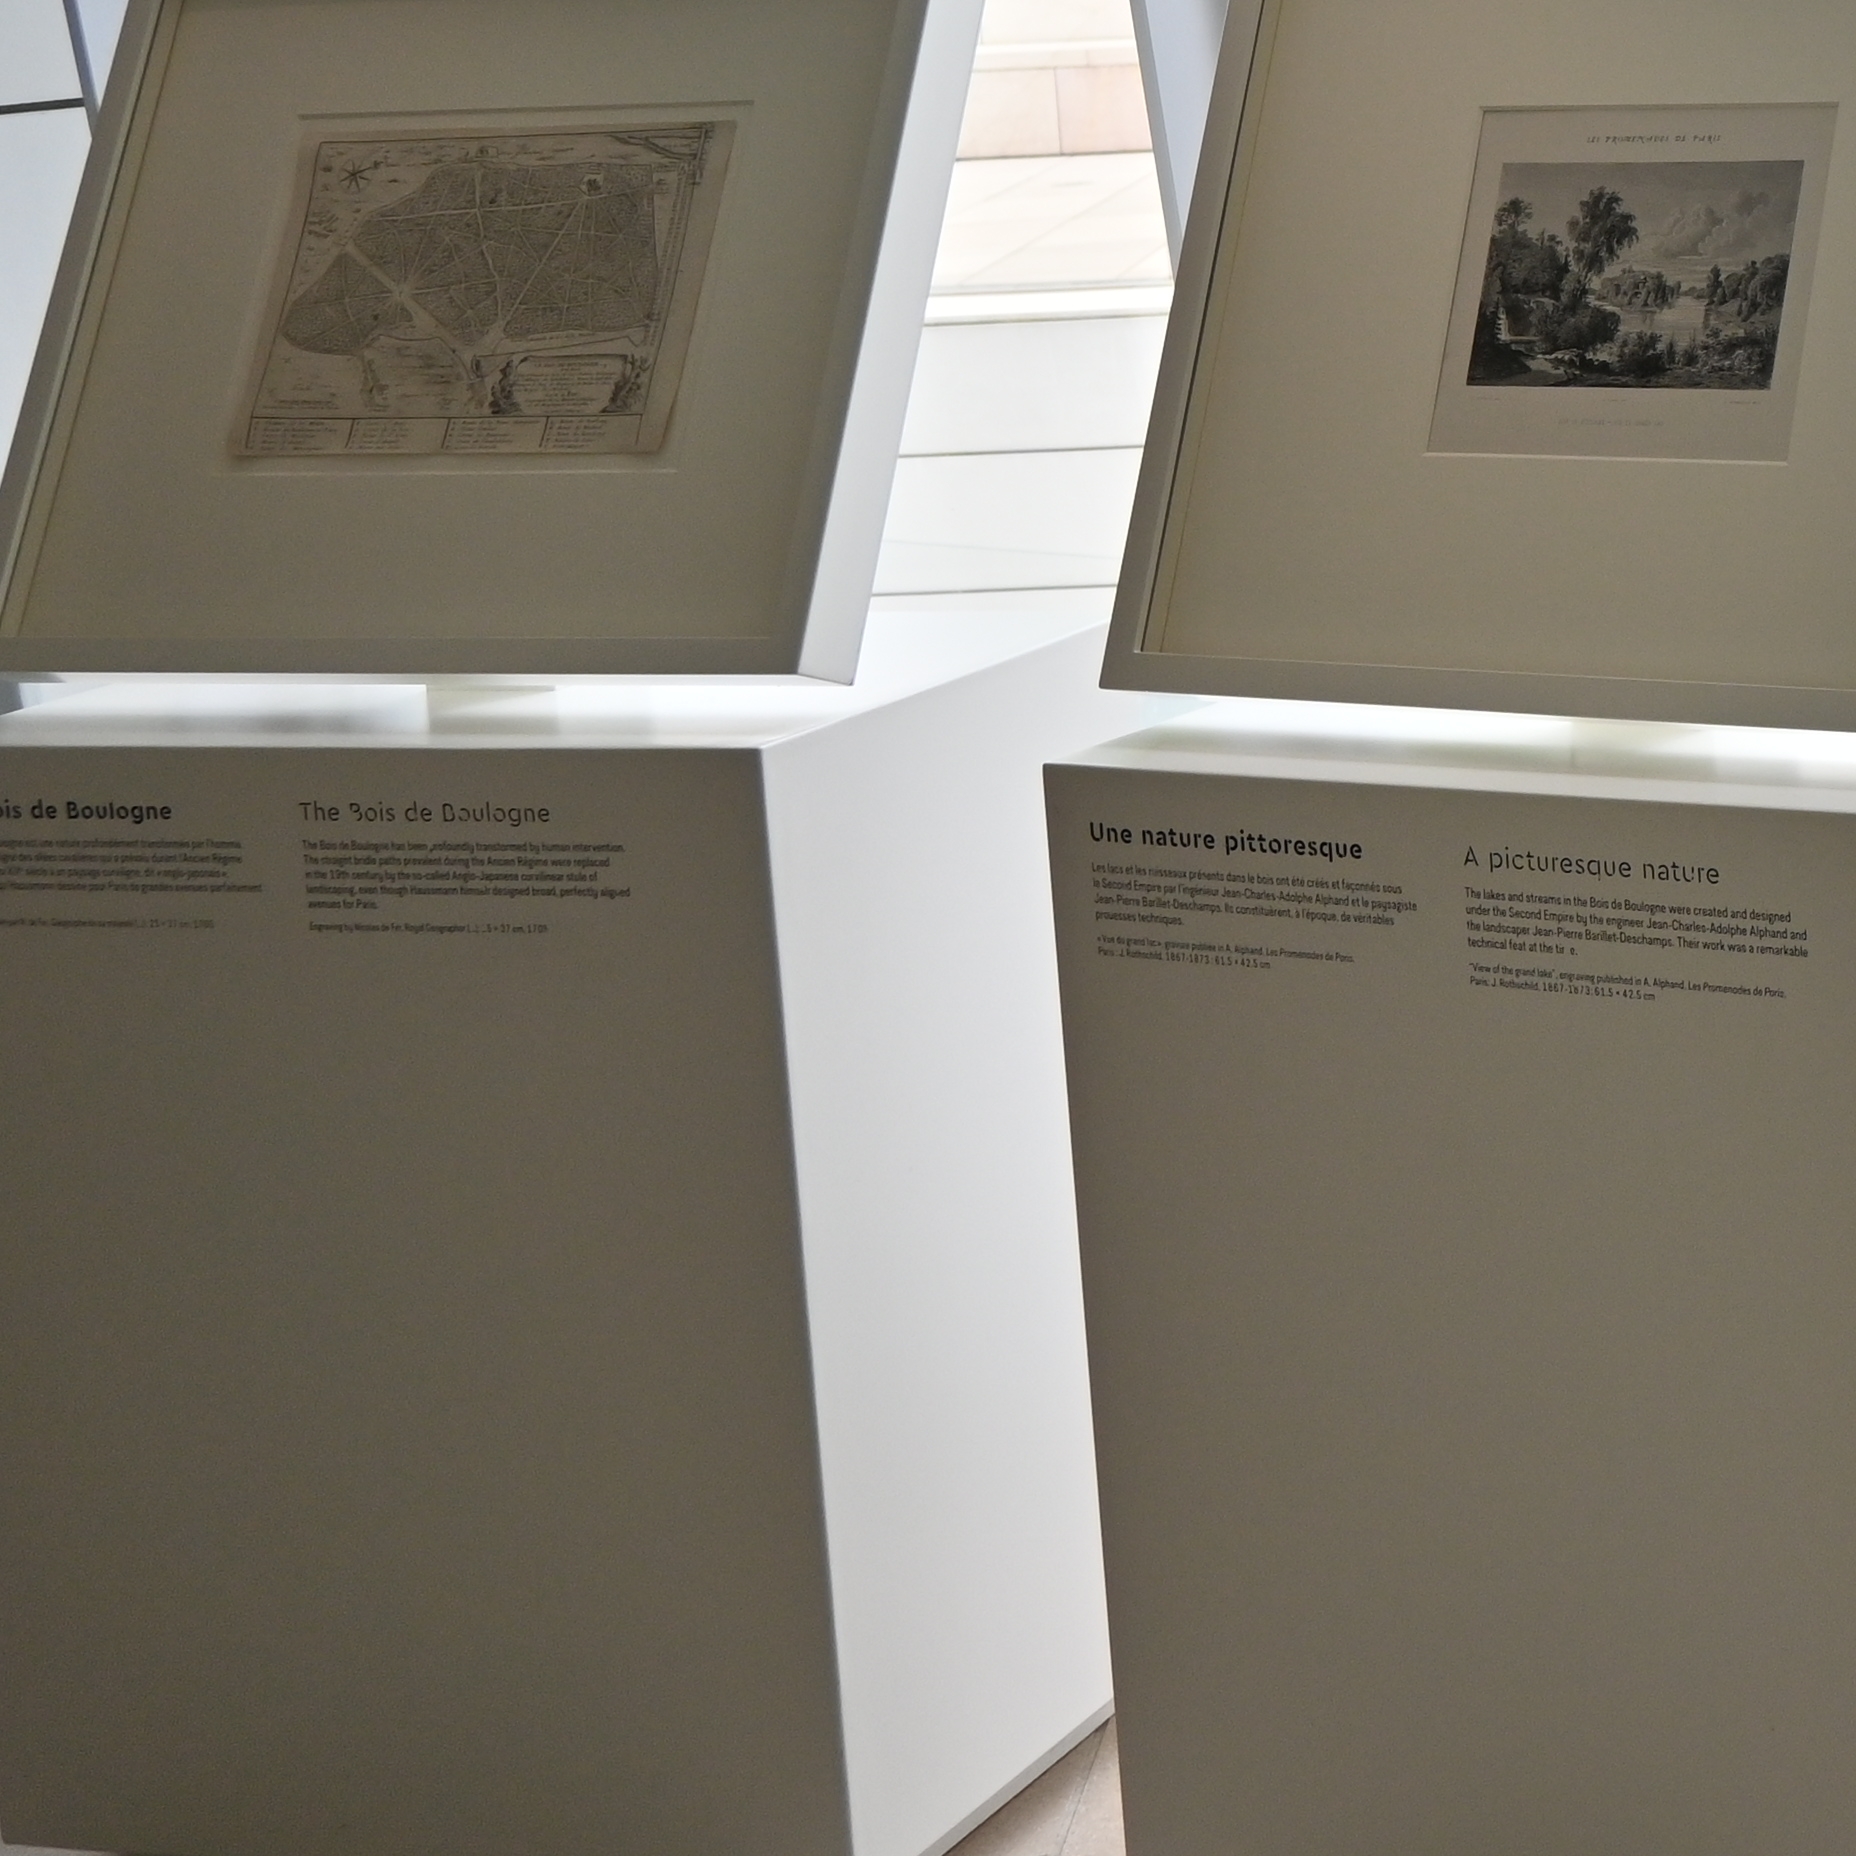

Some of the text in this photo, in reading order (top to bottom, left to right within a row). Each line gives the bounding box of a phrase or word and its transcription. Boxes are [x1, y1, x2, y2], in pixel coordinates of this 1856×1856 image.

[0, 798, 172, 824] is de Boulogne
[298, 800, 550, 827] The Bois de Boulogne
[1090, 821, 1362, 862] Une nature pittoresque
[1464, 846, 1719, 884] A picturesque nature
[1464, 886, 1791, 925] The lakes and streams in the Bois de Boulogne were created and designed
[1465, 904, 1807, 941] under the Second Empire by the engineer Jean-Charles-Adolphe Alphand and
[1466, 919, 1481, 931] the
[1482, 920, 1530, 937] landscaper
[1532, 925, 1583, 940] Jean-Pierre
[1676, 935, 1700, 949] Their
[1701, 939, 1725, 951] work
[1727, 944, 1747, 953] was
[1748, 944, 1754, 953] a
[1756, 945, 1809, 957] remarkable
[1467, 936, 1507, 949] technical
[1508, 938, 1526, 951] feat
[1528, 942, 1537, 952] at
[1539, 941, 1554, 953] the
